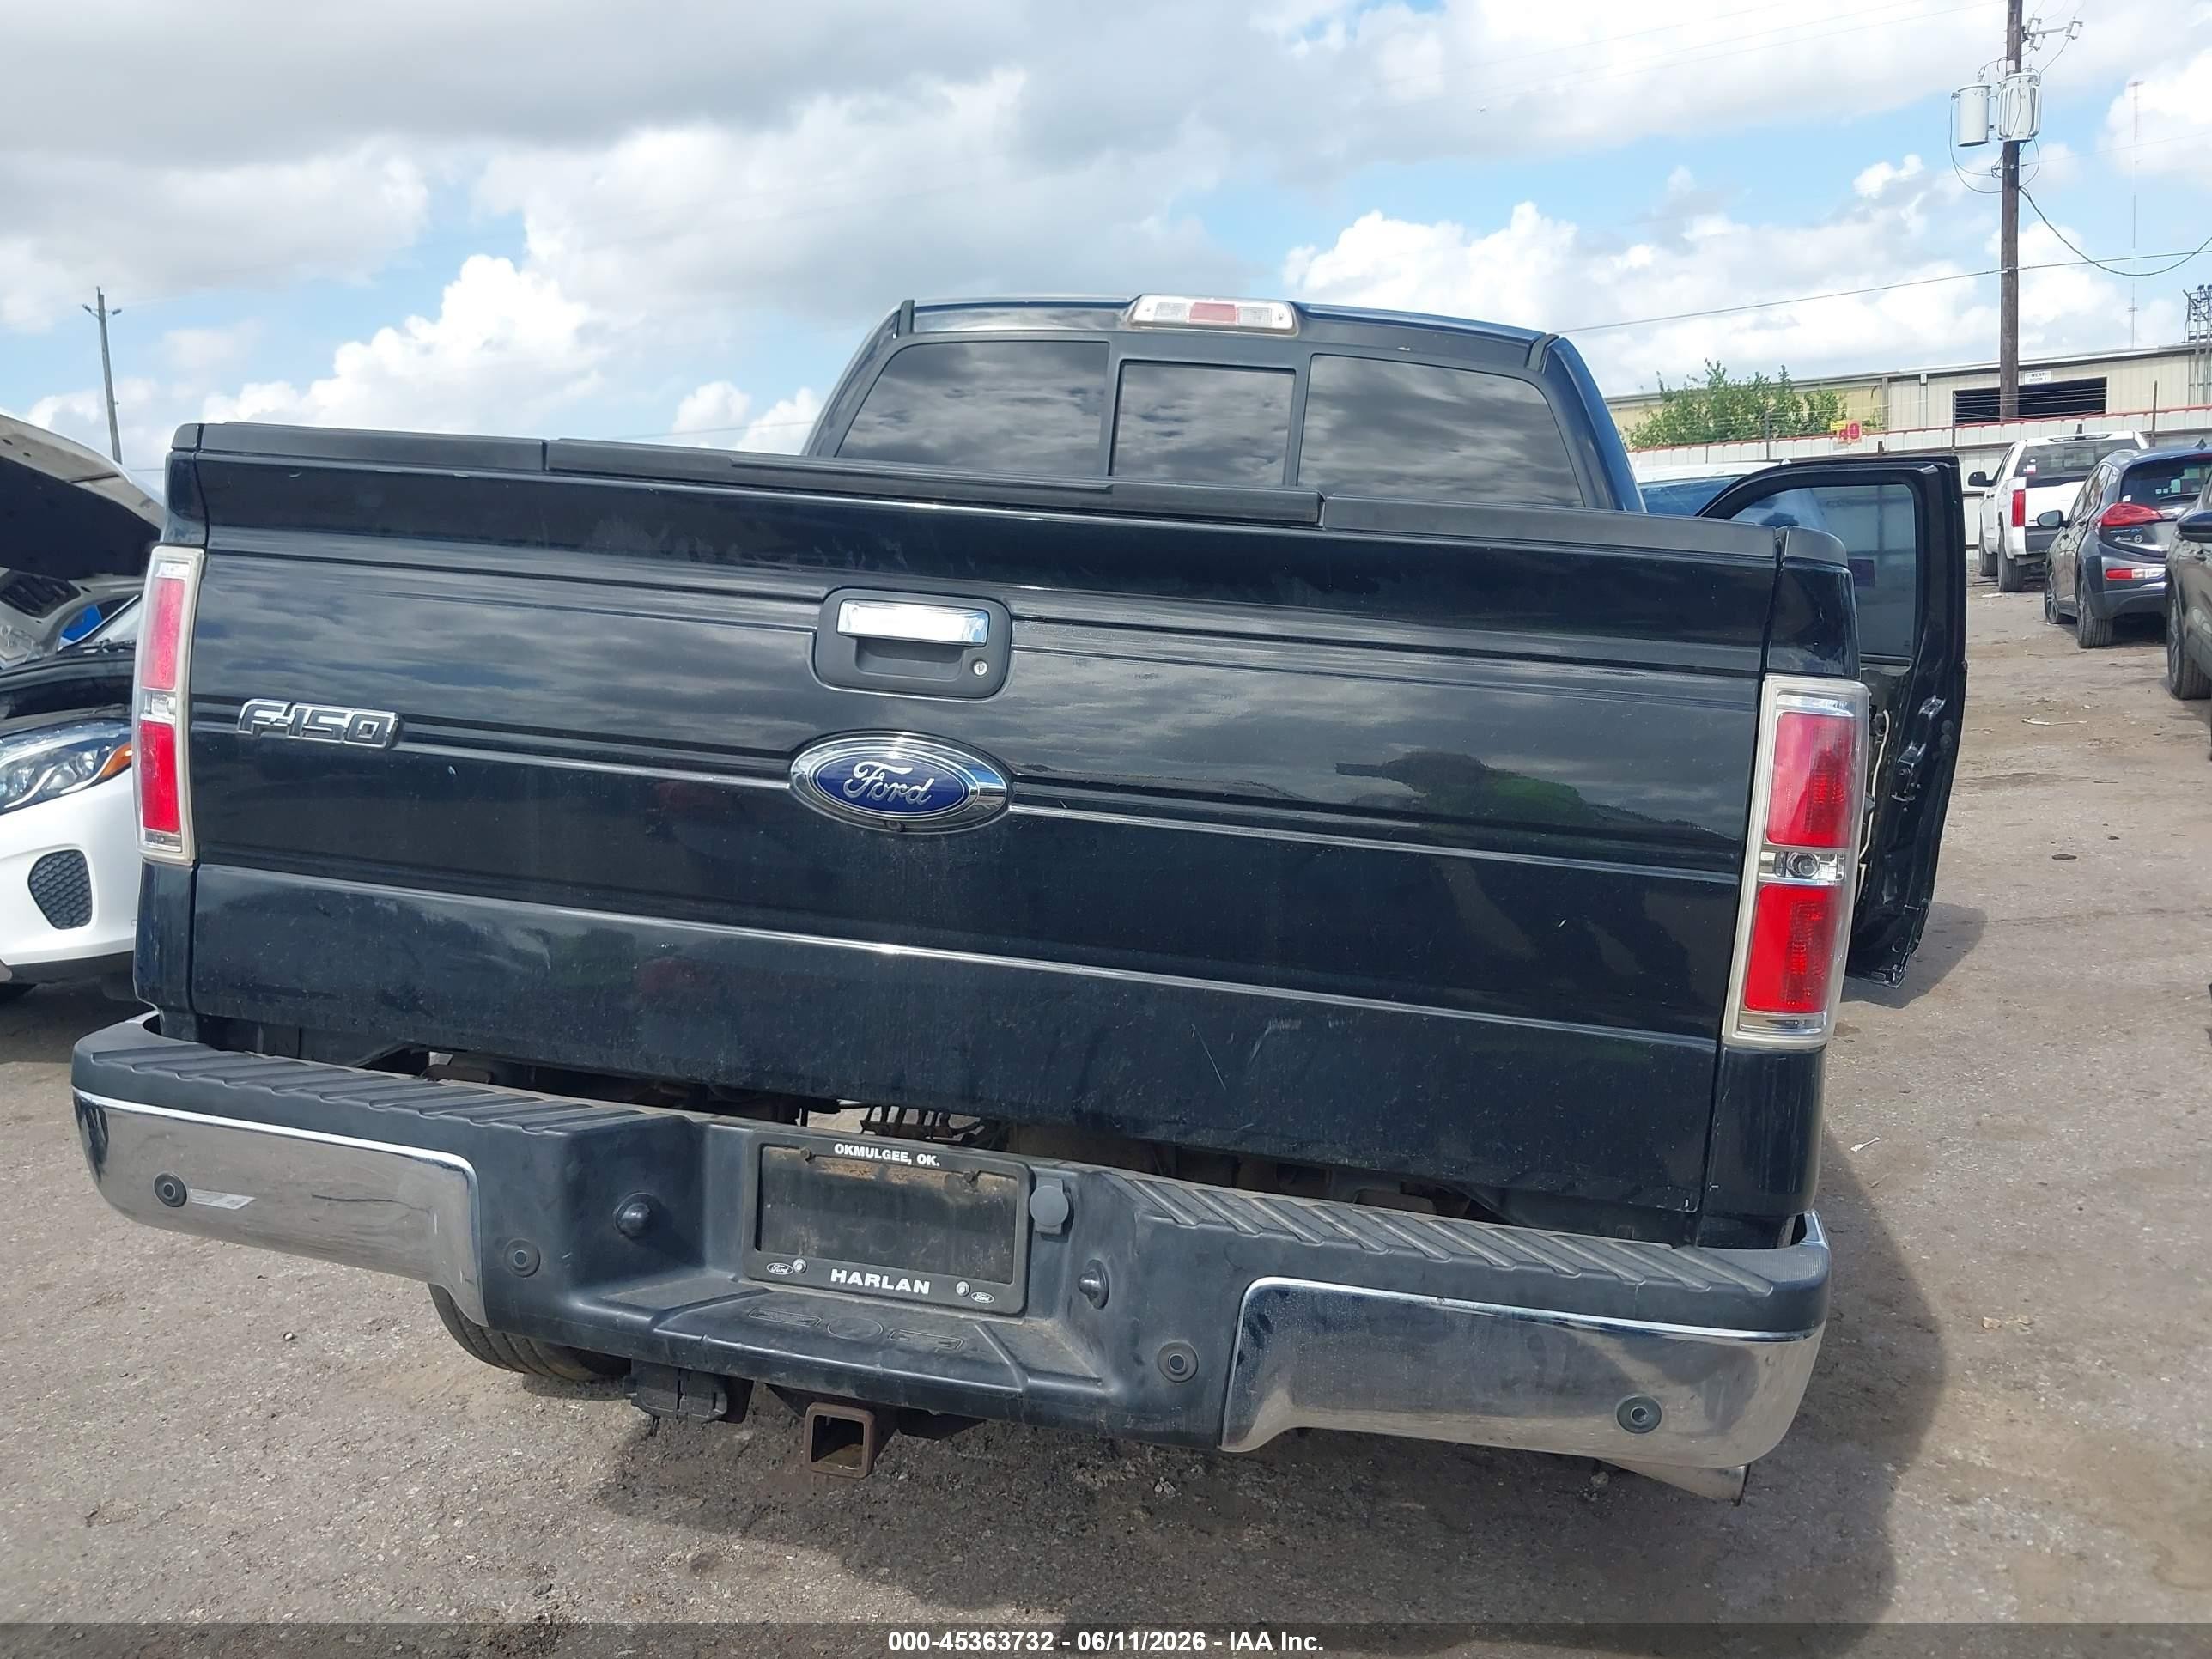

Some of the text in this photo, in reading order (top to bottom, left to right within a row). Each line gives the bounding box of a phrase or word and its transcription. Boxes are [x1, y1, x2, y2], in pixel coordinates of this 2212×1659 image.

[237, 698, 398, 748] F-150
[843, 761, 935, 805] Ford
[834, 1143, 940, 1166] OKMULGEE, OK.
[769, 1264, 790, 1274] Ford
[830, 1268, 930, 1294] HARLAN
[973, 1292, 992, 1302] Ford
